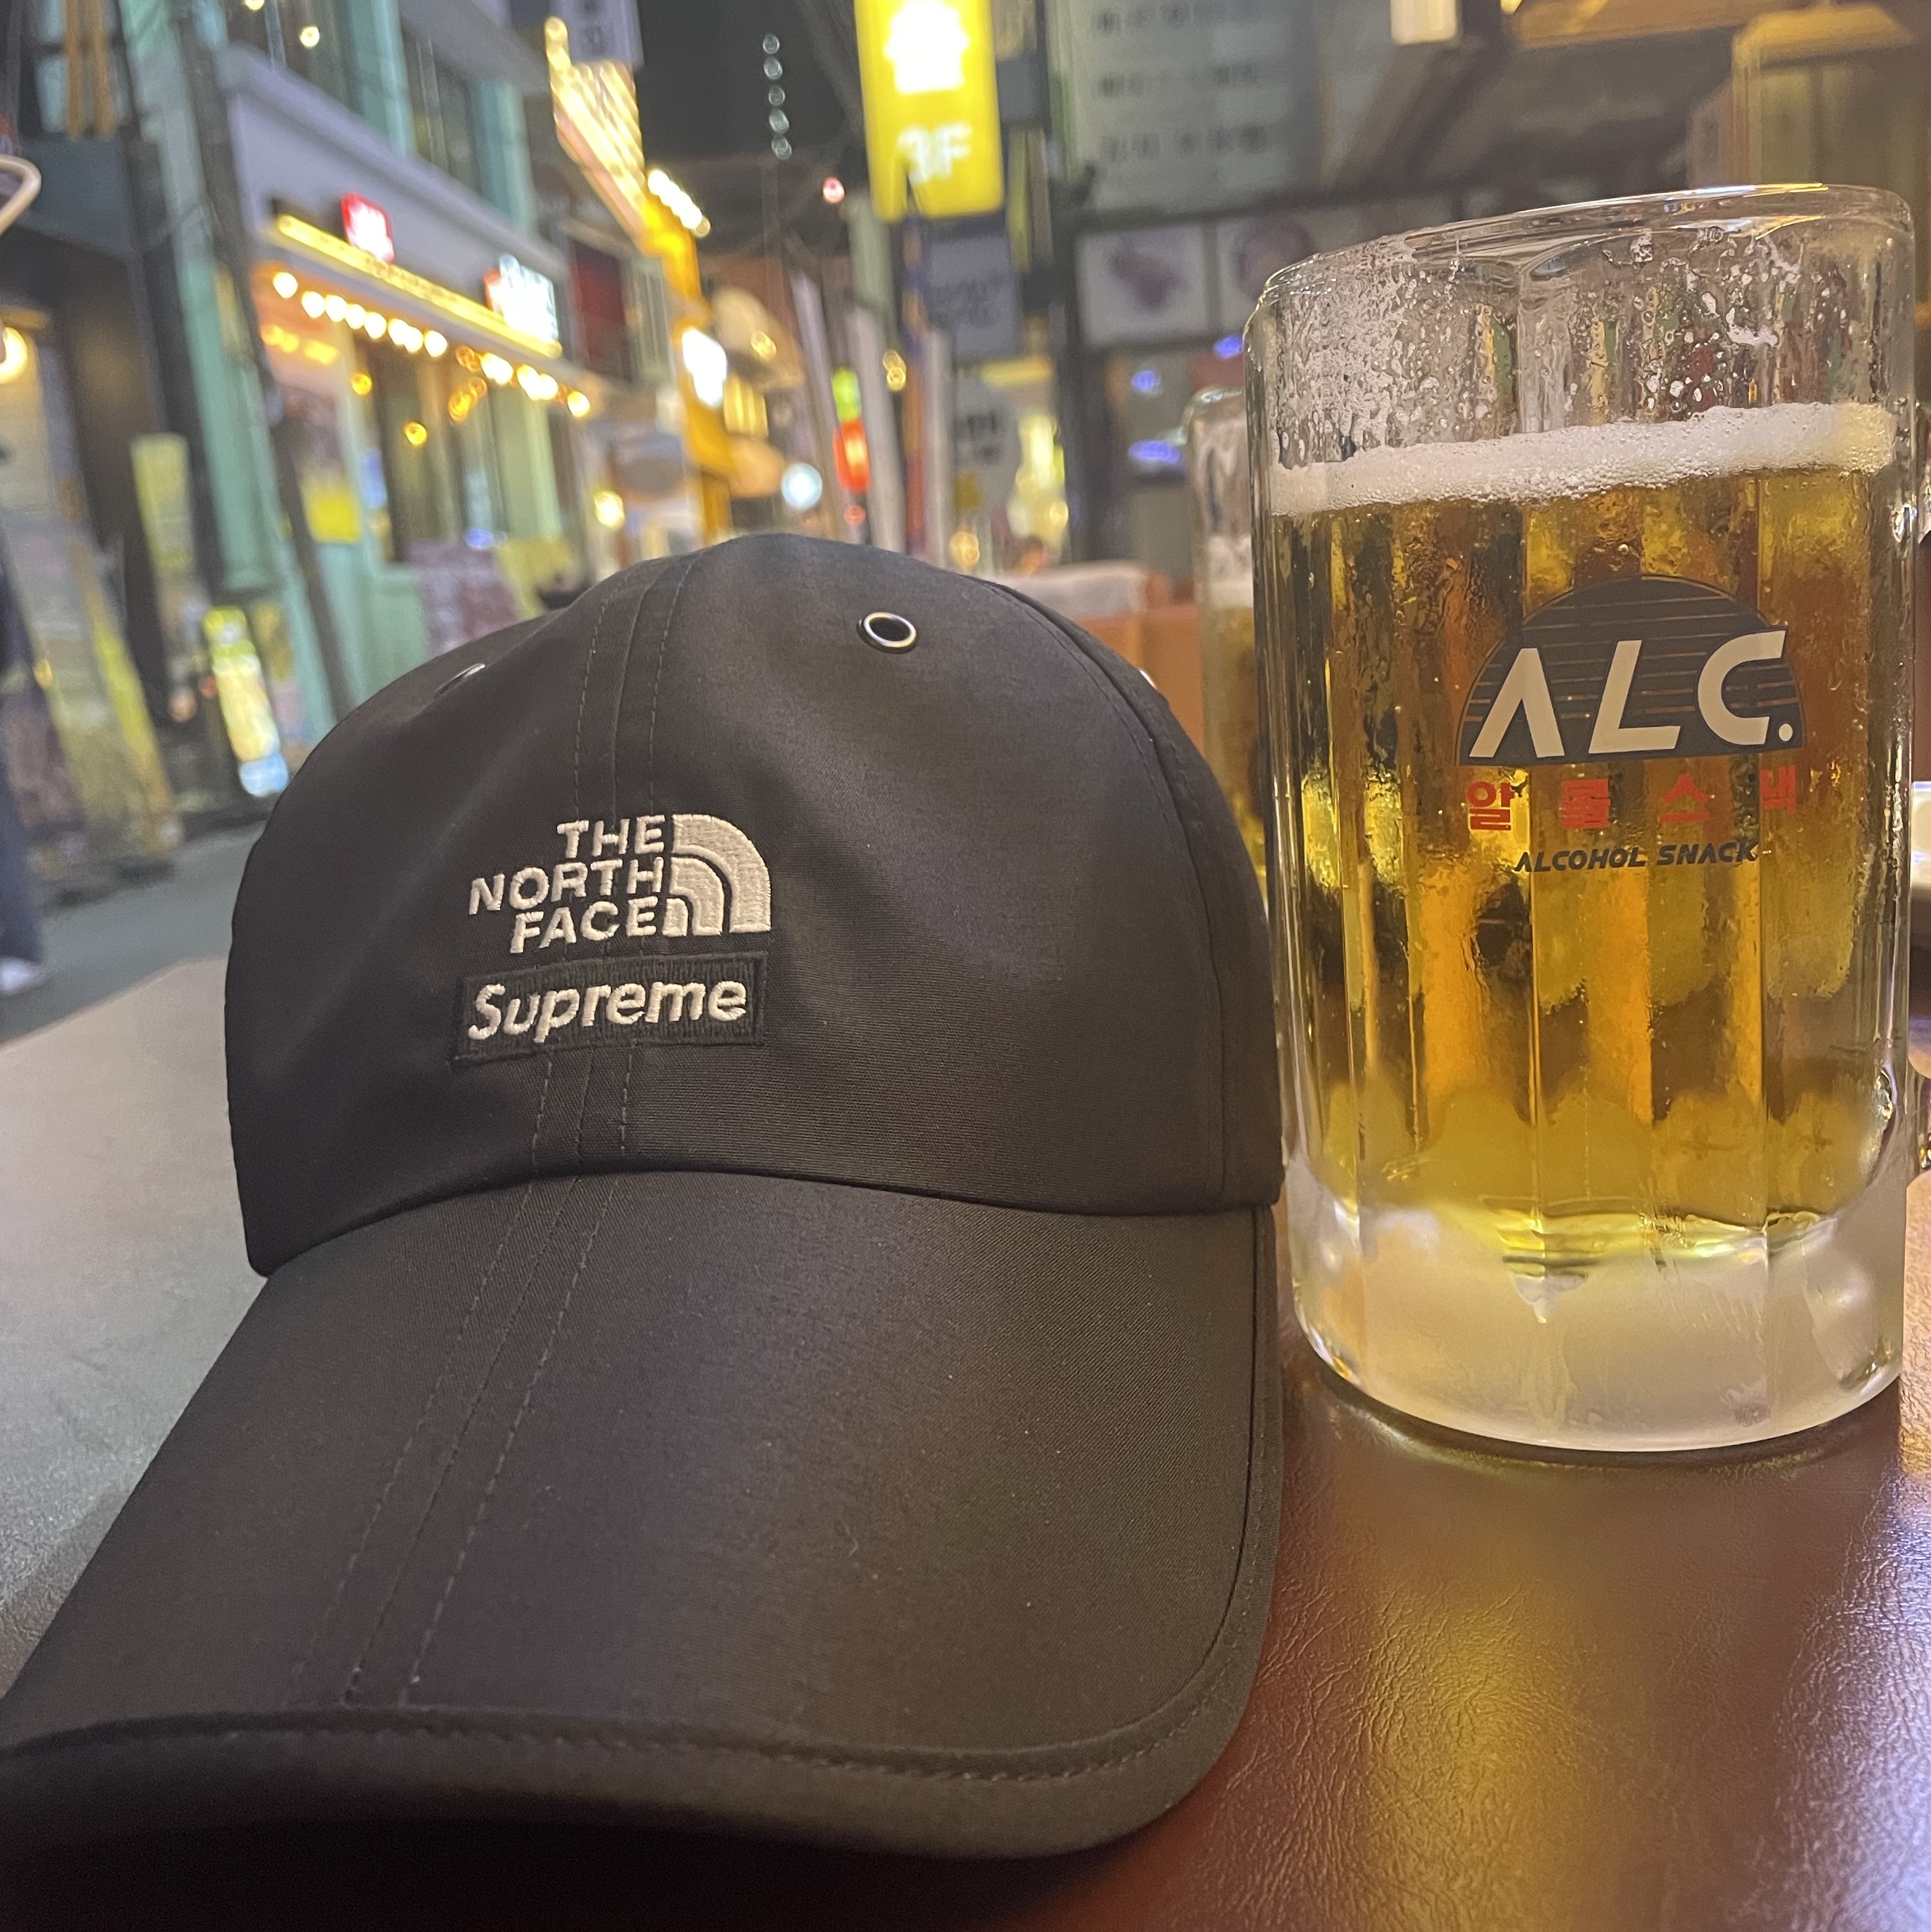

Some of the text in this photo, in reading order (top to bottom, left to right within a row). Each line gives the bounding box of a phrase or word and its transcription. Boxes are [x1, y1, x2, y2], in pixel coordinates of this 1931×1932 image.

[557, 814, 665, 858] THE
[1514, 840, 1760, 872] ALCOHOL SNACK
[468, 856, 665, 915] NORTH
[510, 895, 659, 954] FACE
[467, 979, 747, 1043] Supreme
